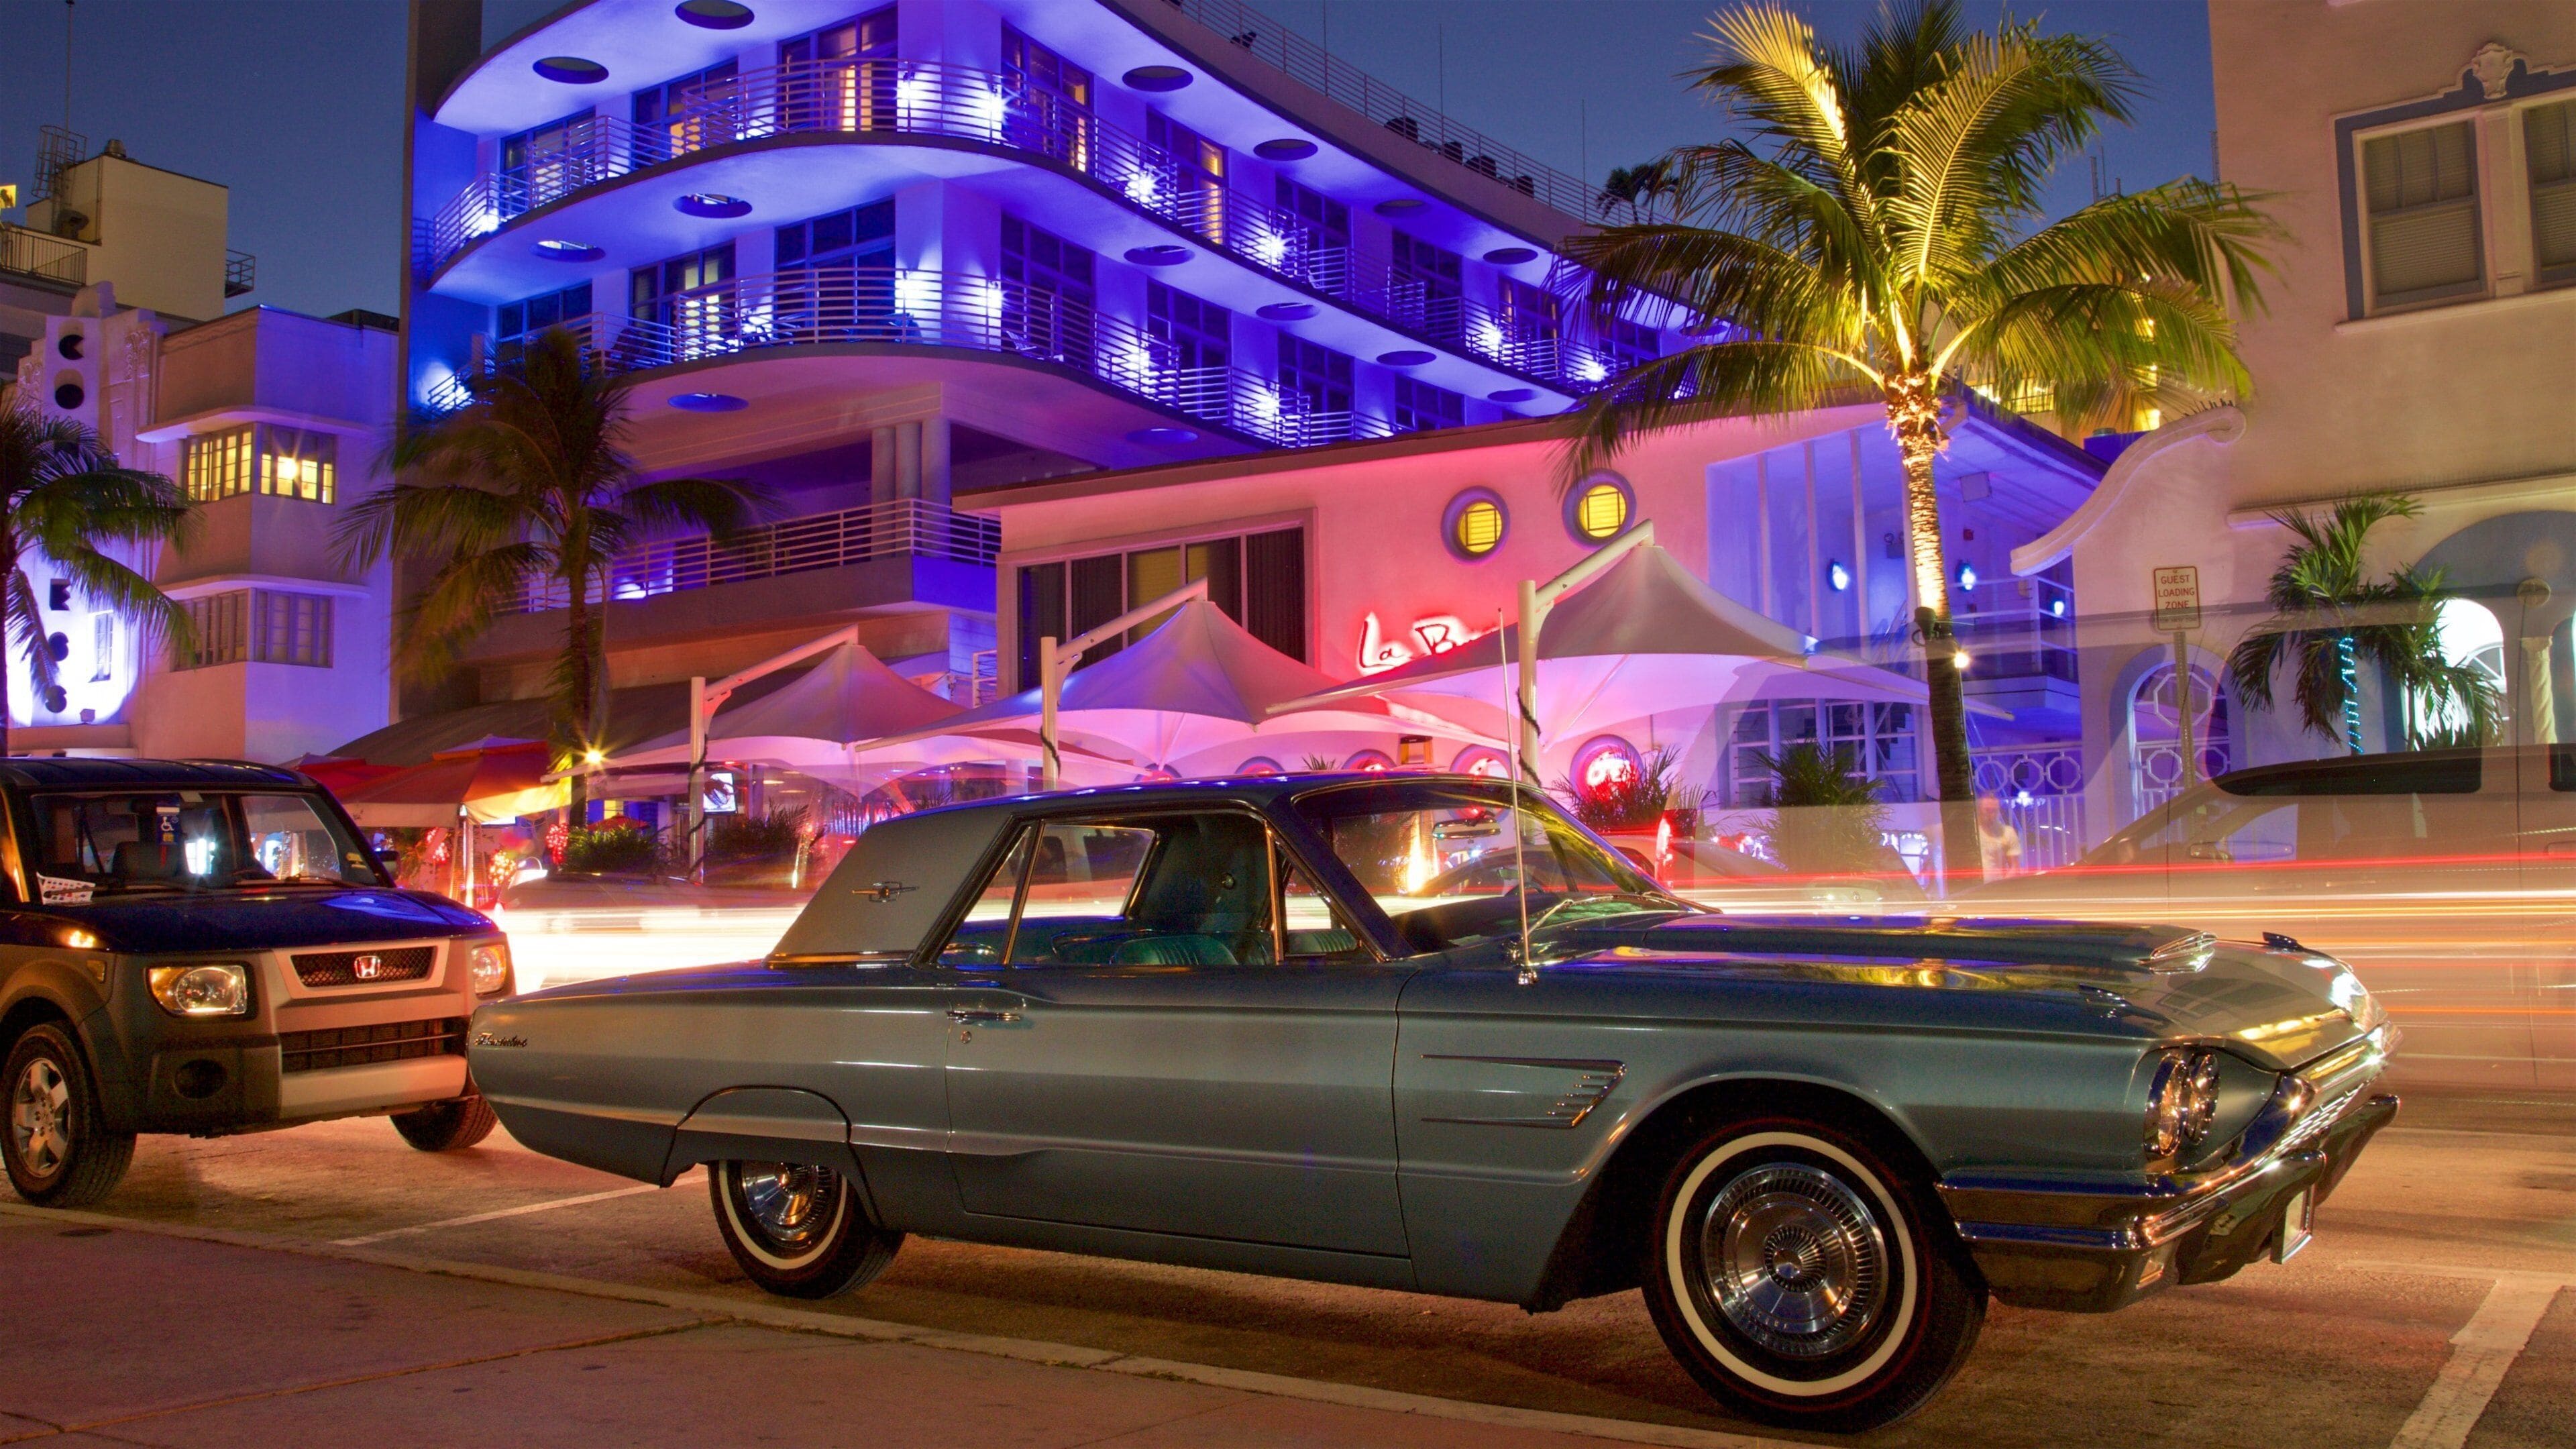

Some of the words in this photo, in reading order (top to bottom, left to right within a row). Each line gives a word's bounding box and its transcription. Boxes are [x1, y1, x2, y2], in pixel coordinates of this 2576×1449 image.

[2161, 575, 2190, 584] GUEST
[2158, 588, 2195, 598] LOADING
[2165, 600, 2190, 610] ZONE
[1359, 616, 1407, 671] La
